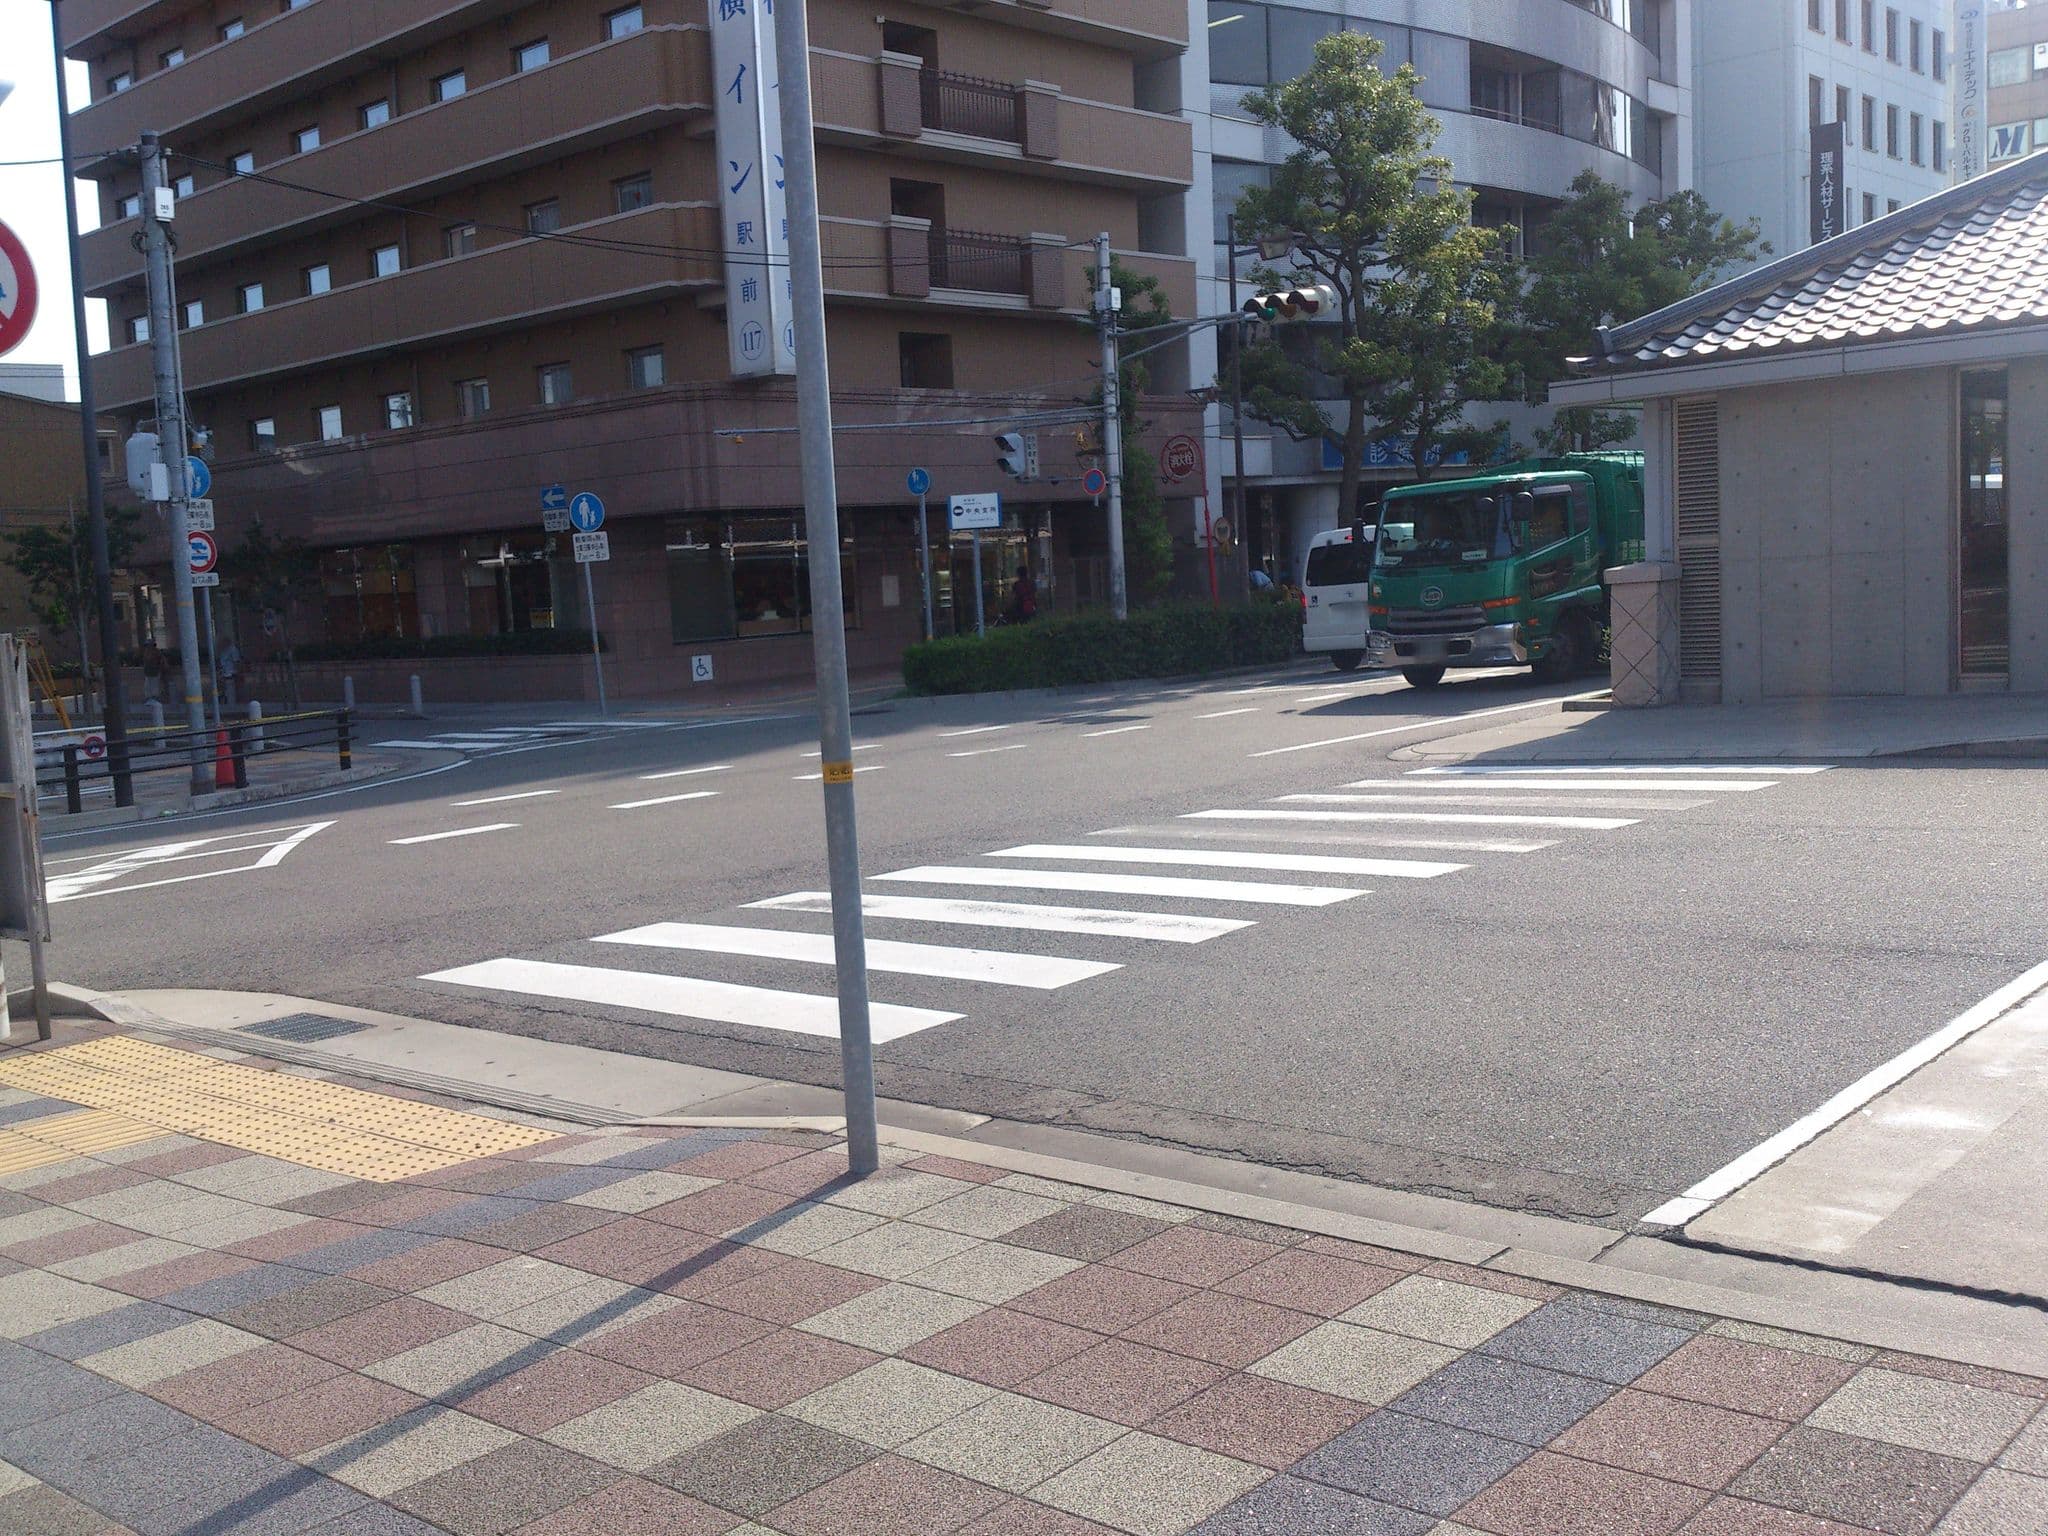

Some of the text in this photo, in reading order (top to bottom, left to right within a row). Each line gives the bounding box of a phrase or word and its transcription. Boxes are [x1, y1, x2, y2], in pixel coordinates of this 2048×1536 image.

[1991, 125, 2027, 158] M
[1820, 151, 1834, 240] 理系人材サービス
